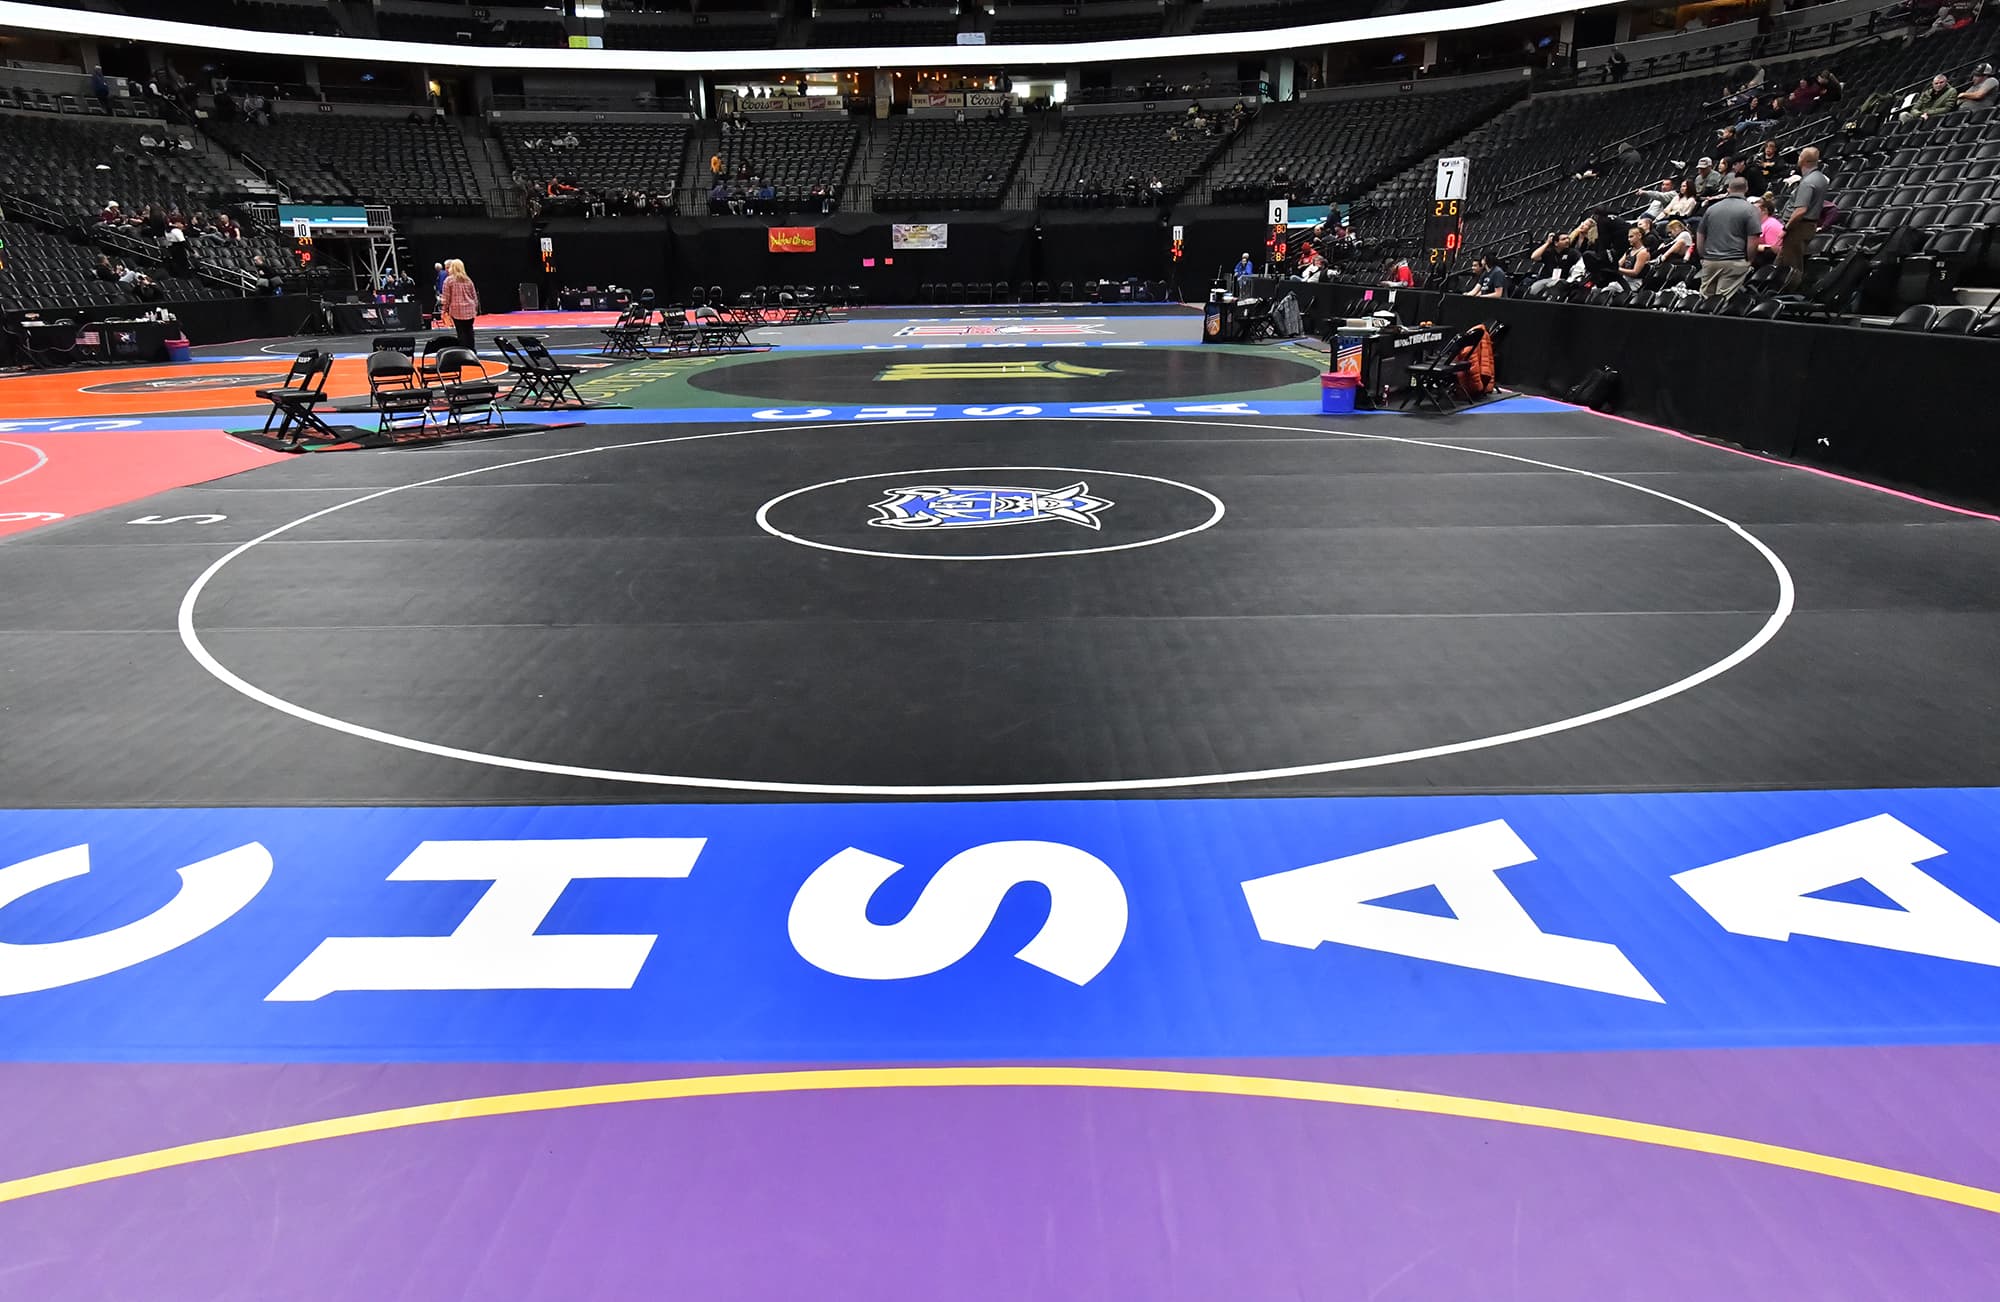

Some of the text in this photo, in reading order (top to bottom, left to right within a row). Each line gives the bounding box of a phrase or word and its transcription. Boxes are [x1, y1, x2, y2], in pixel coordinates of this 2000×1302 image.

[1445, 170, 1454, 198] 7
[1274, 206, 1282, 223] 9
[297, 223, 307, 237] 10
